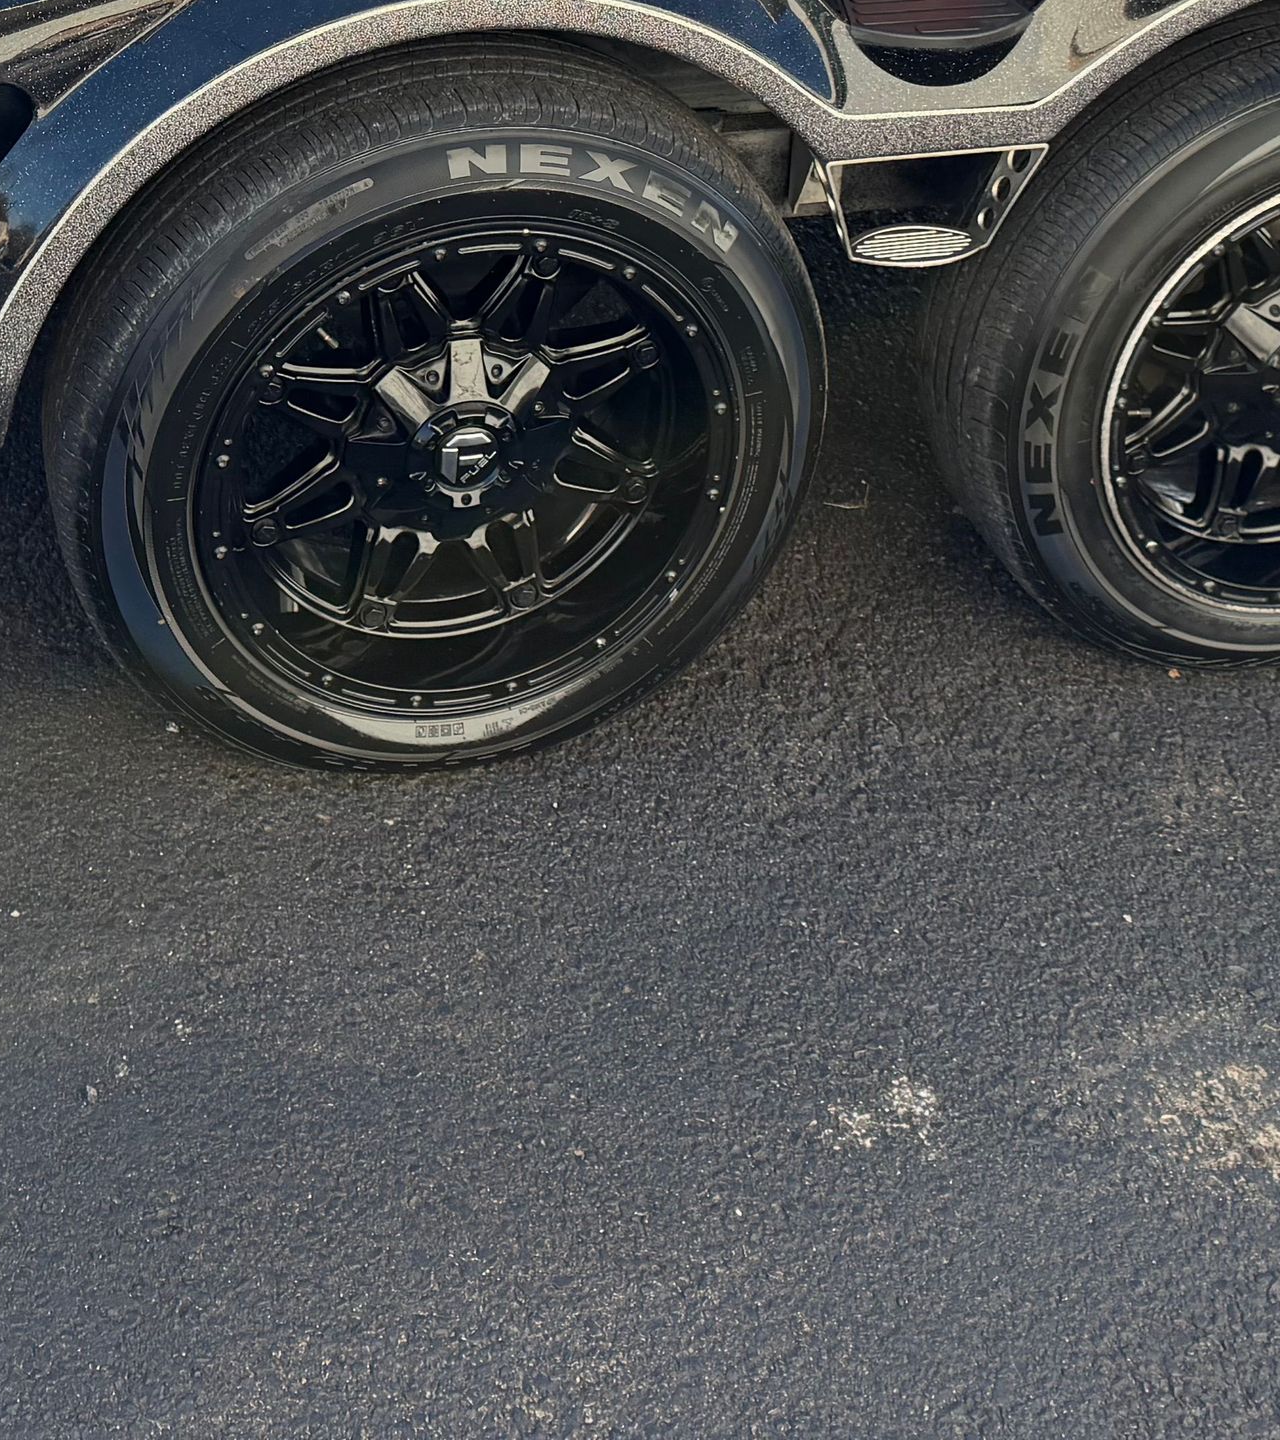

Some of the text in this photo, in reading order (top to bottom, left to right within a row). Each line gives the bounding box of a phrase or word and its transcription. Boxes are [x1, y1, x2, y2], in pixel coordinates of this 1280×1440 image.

[446, 143, 740, 254] NEXEN
[1023, 264, 1113, 537] NEXEN
[460, 451, 497, 484] FUEL
